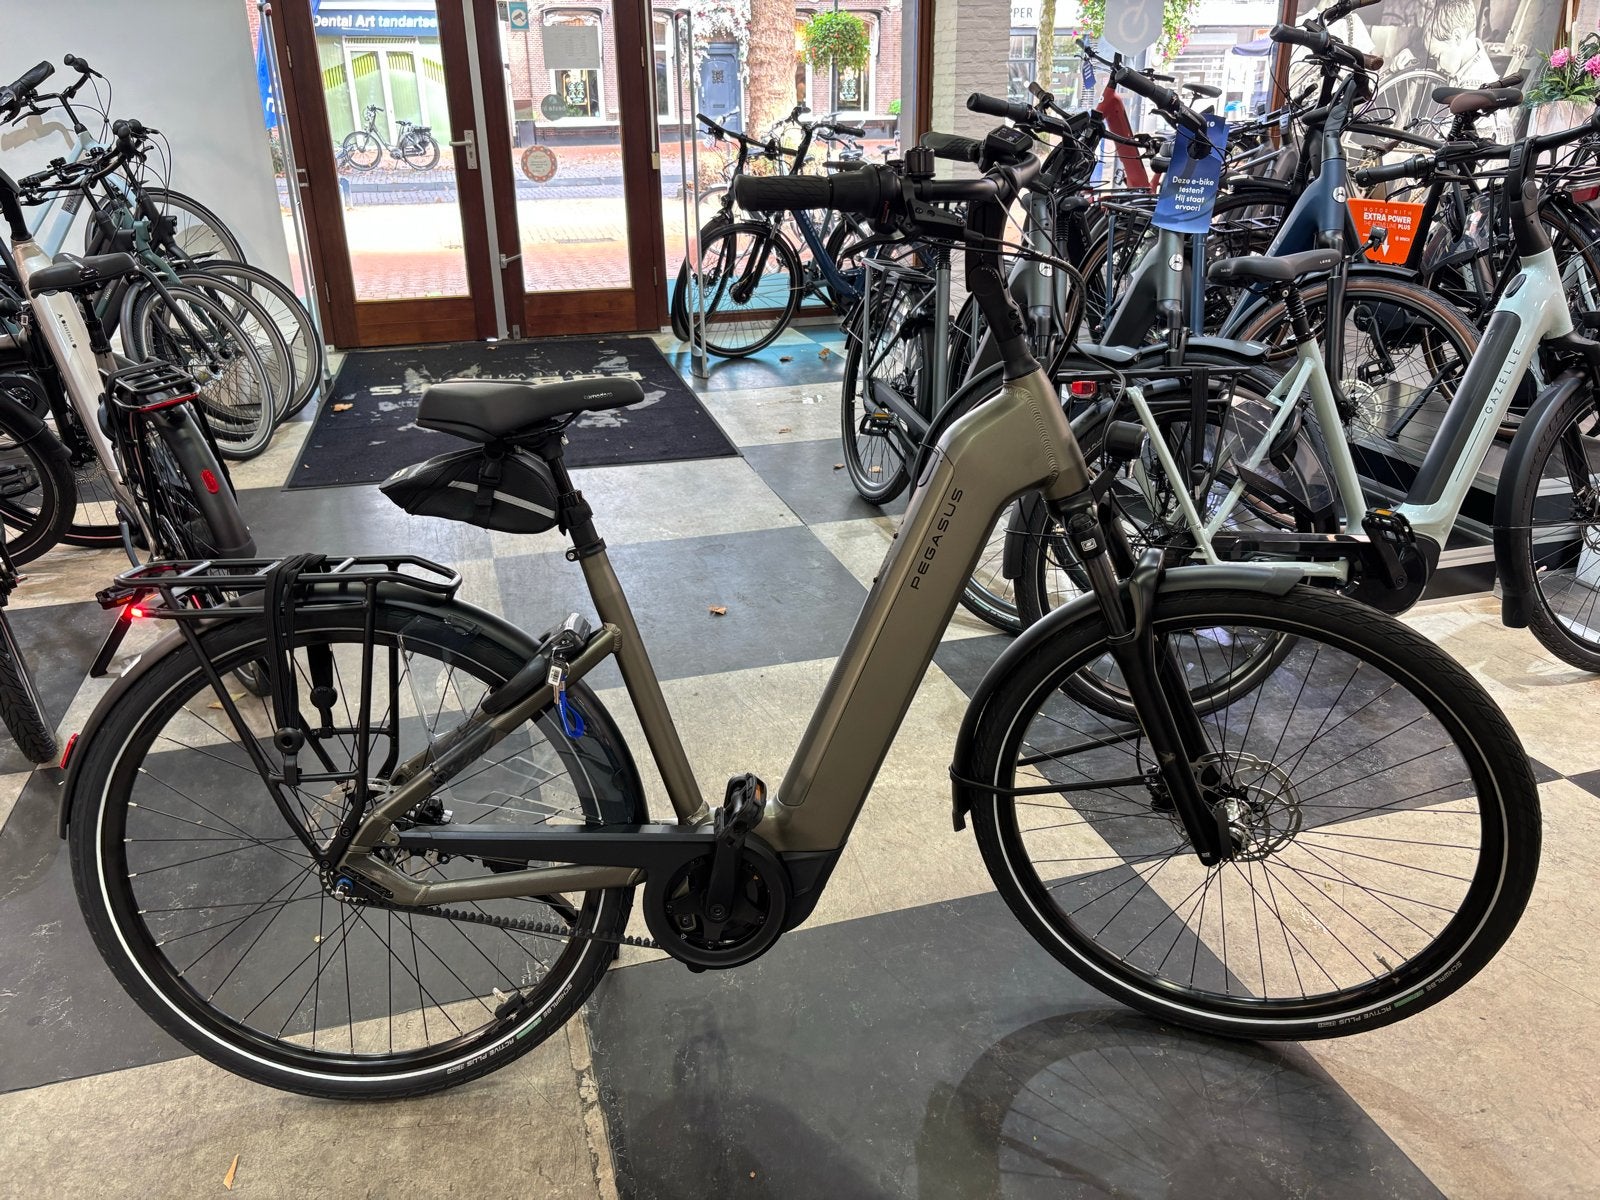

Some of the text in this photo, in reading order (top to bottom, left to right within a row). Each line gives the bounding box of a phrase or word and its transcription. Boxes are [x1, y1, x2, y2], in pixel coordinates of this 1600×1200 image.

[355, 14, 376, 28] Art
[1172, 176, 1215, 186] Deze e-bike
[1175, 194, 1205, 203] Hij staat
[1363, 212, 1412, 224] EXTRA POWER
[1397, 223, 1411, 231] PLUS
[1485, 348, 1521, 414] GAZELLE
[910, 488, 963, 590] PEGASUS
[1425, 960, 1463, 992] SCHWALBE
[542, 982, 573, 1019] SCHWALBE
[1363, 1005, 1392, 1020] ACTIVE
[1338, 1015, 1362, 1026] PLUS
[467, 1038, 515, 1067] ACTIVE PLUS
